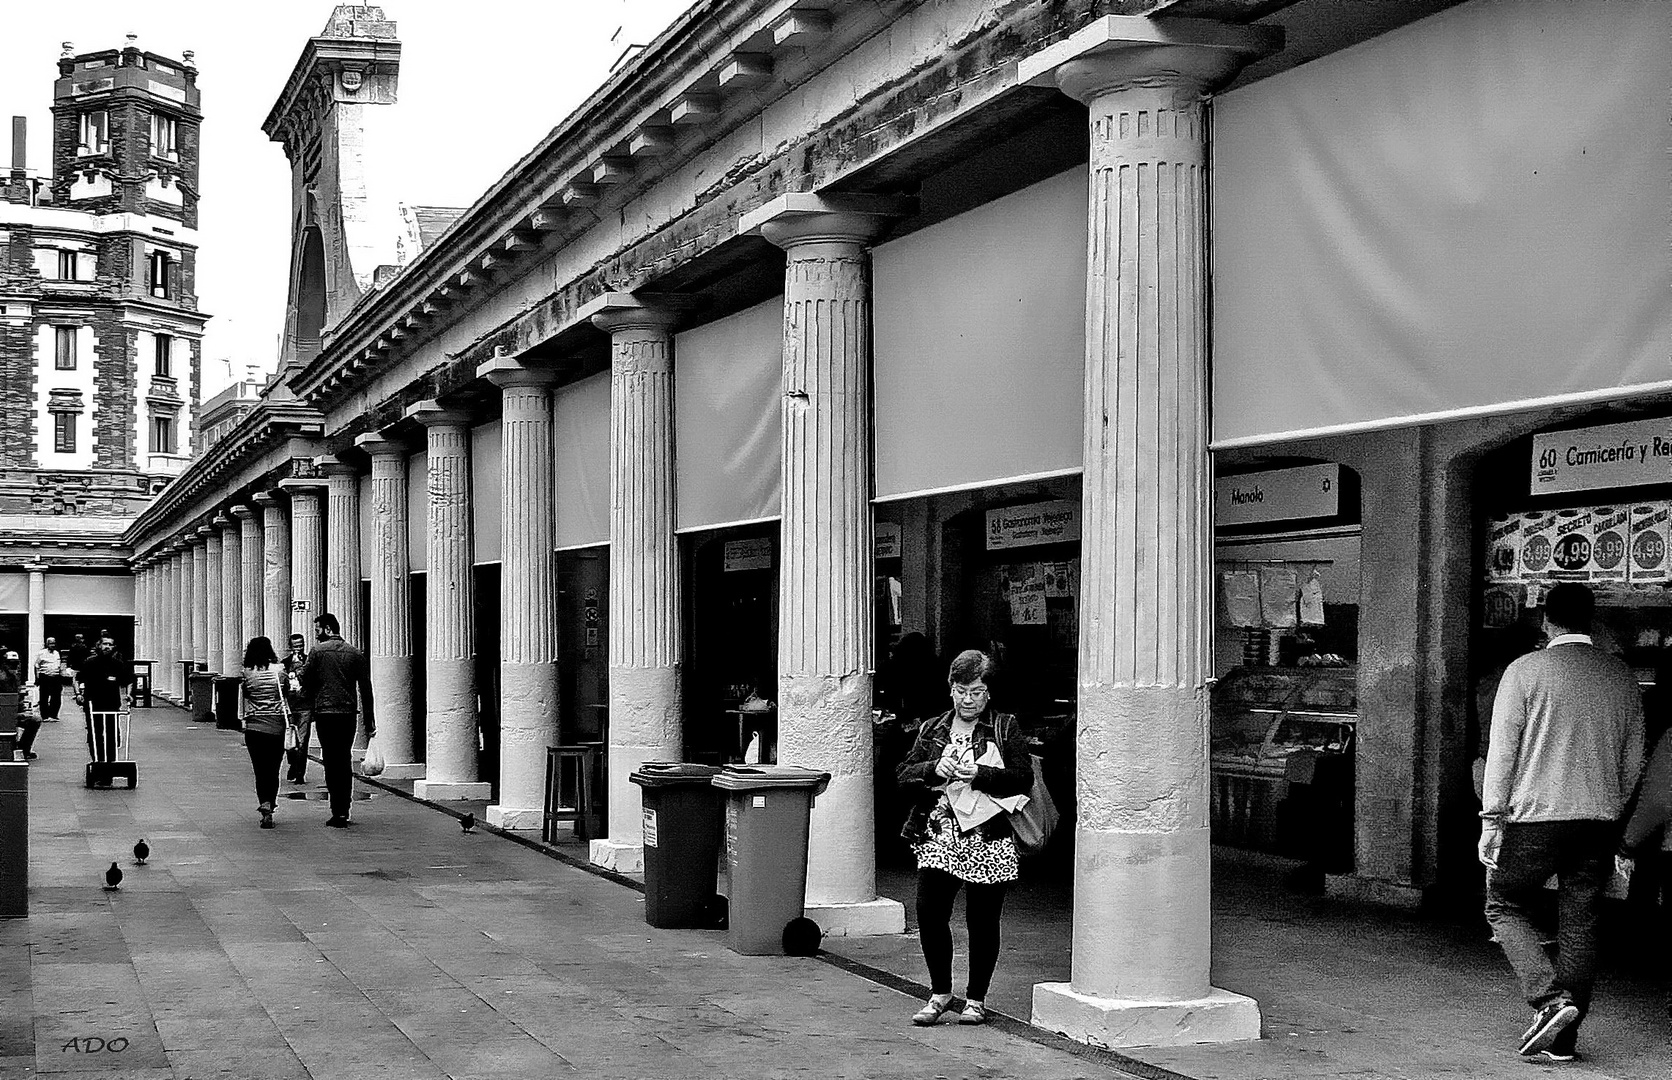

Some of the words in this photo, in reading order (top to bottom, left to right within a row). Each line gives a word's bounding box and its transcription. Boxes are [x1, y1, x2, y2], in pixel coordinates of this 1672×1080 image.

[1539, 449, 1557, 469] 60
[1639, 444, 1648, 464] y
[1231, 485, 1264, 505] Manolo
[1556, 512, 1592, 537] SECRETO
[1523, 544, 1551, 564] 3,99
[1554, 541, 1591, 567] 4,99
[1634, 540, 1663, 561] 4,99
